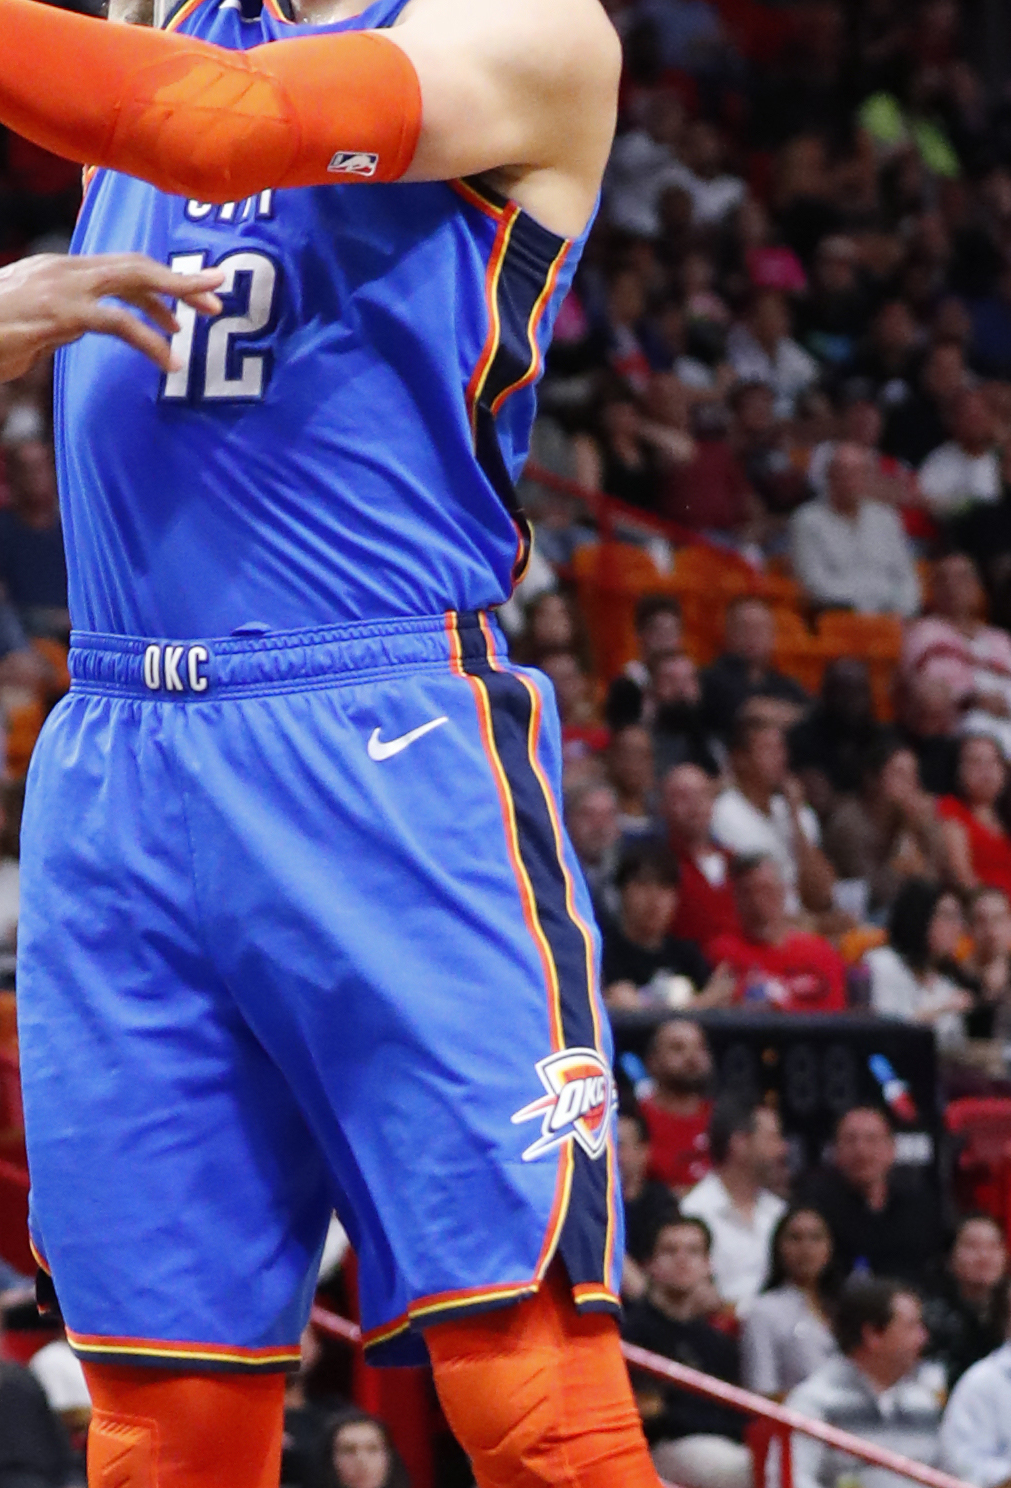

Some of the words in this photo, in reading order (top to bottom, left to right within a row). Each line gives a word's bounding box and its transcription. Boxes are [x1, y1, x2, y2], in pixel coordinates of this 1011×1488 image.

[160, 248, 281, 401] 12
[144, 643, 208, 692] OKC
[550, 1074, 606, 1131] OKC
